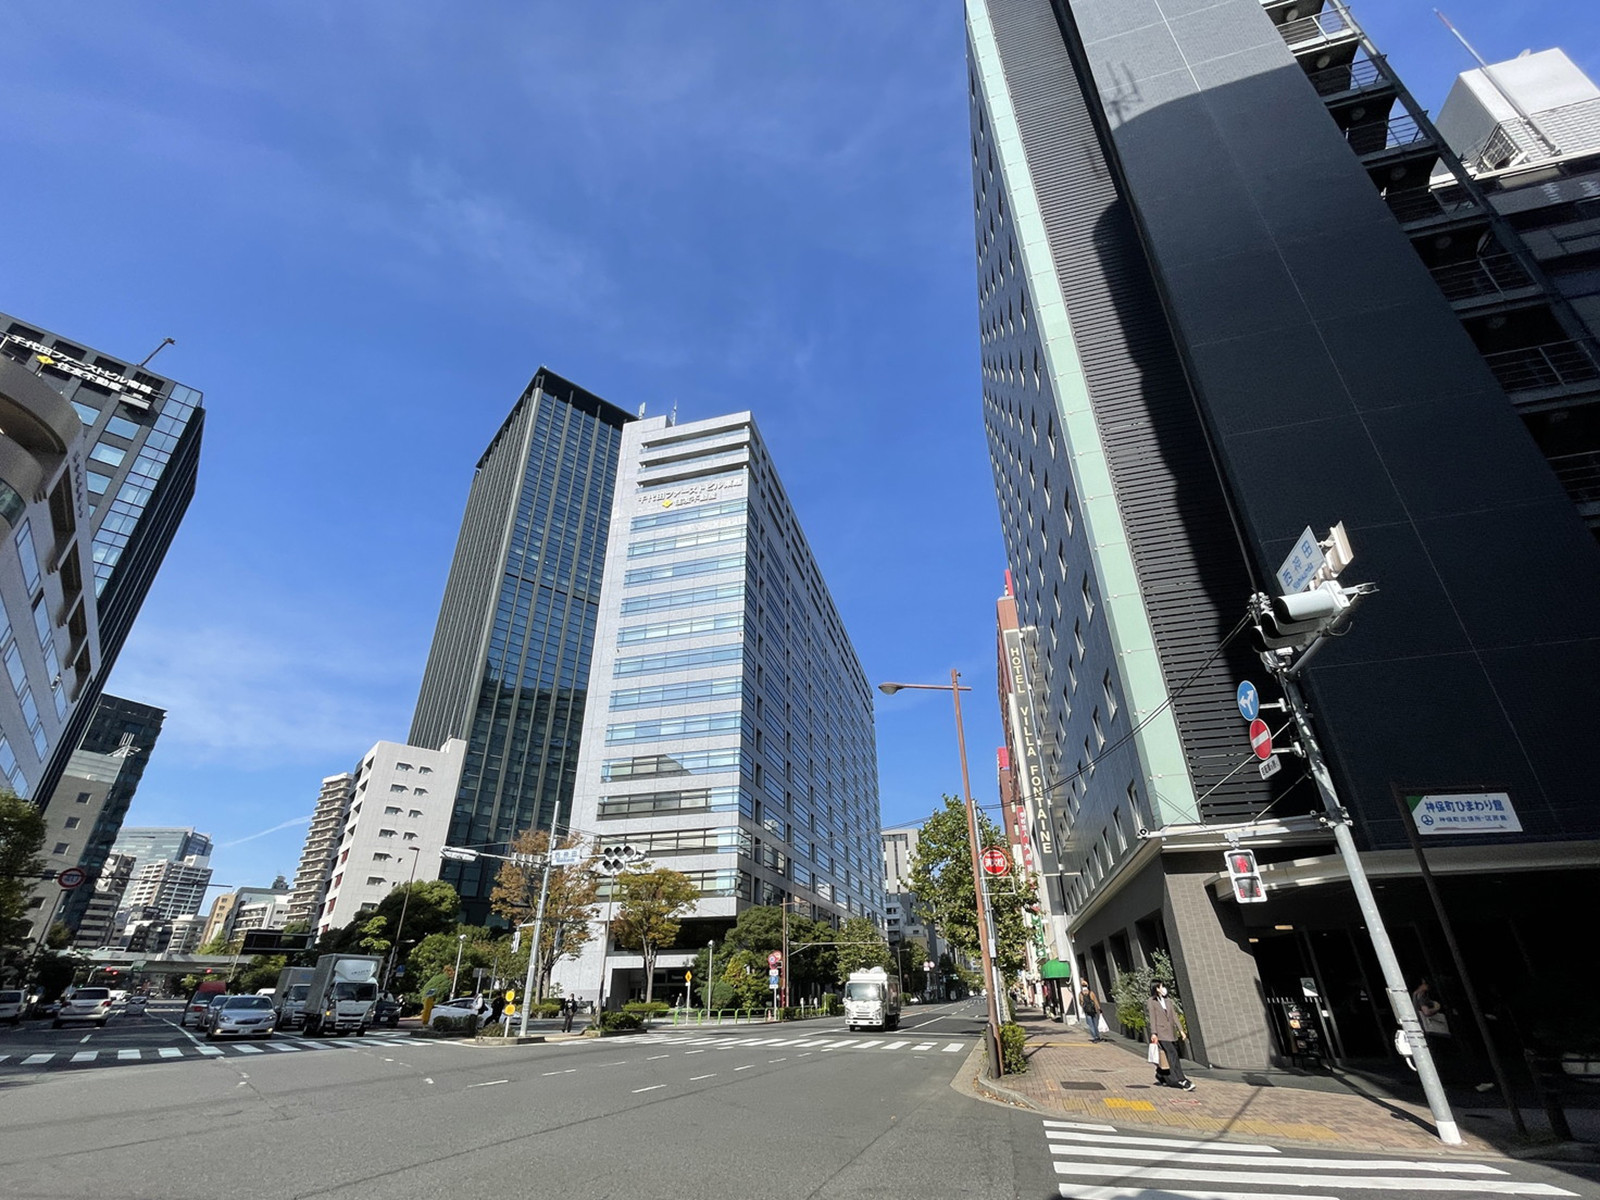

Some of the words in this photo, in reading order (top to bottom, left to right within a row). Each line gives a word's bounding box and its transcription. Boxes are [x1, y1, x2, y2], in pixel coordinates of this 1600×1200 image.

[1010, 647, 1025, 693] HOTEL
[1020, 706, 1037, 757] VILLA
[1030, 765, 1053, 854] FONTAINE
[1424, 799, 1505, 814] 神保町ひまわり館
